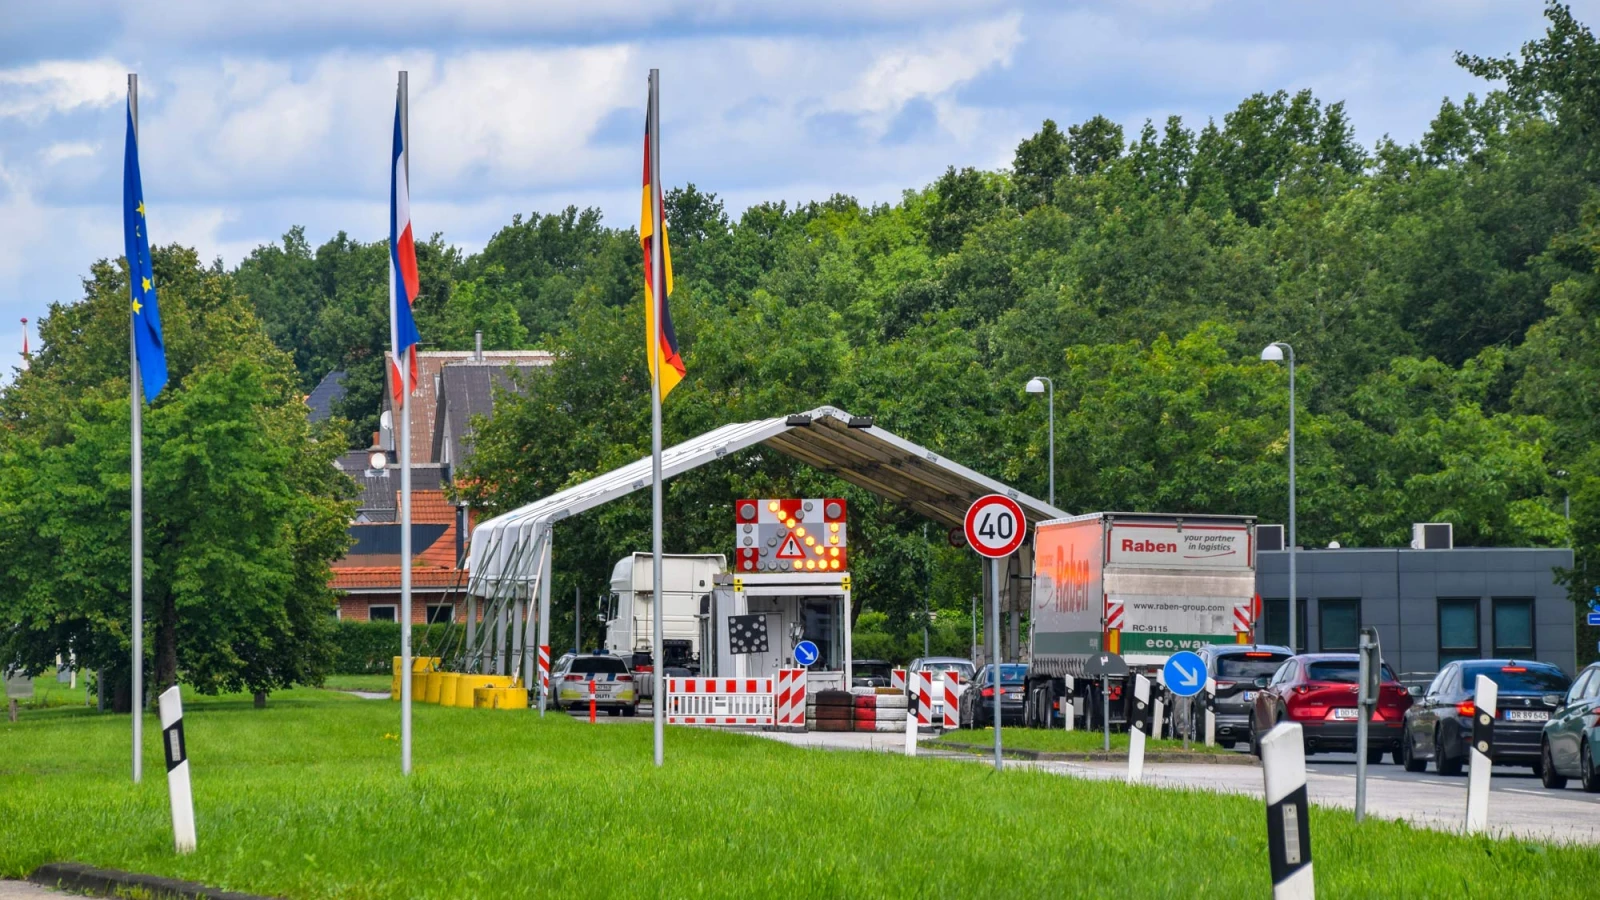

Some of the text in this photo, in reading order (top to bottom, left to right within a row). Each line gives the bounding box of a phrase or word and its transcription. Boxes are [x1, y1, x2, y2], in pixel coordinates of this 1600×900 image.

[979, 512, 1013, 540] 40
[1204, 535, 1235, 543] partner
[1121, 539, 1177, 553] Raben
[1198, 543, 1231, 552] logistics
[1056, 543, 1089, 614] Raben
[1133, 602, 1225, 613] www.raben-group.com
[1132, 624, 1168, 633] RC-9115
[1512, 711, 1522, 719] DR
